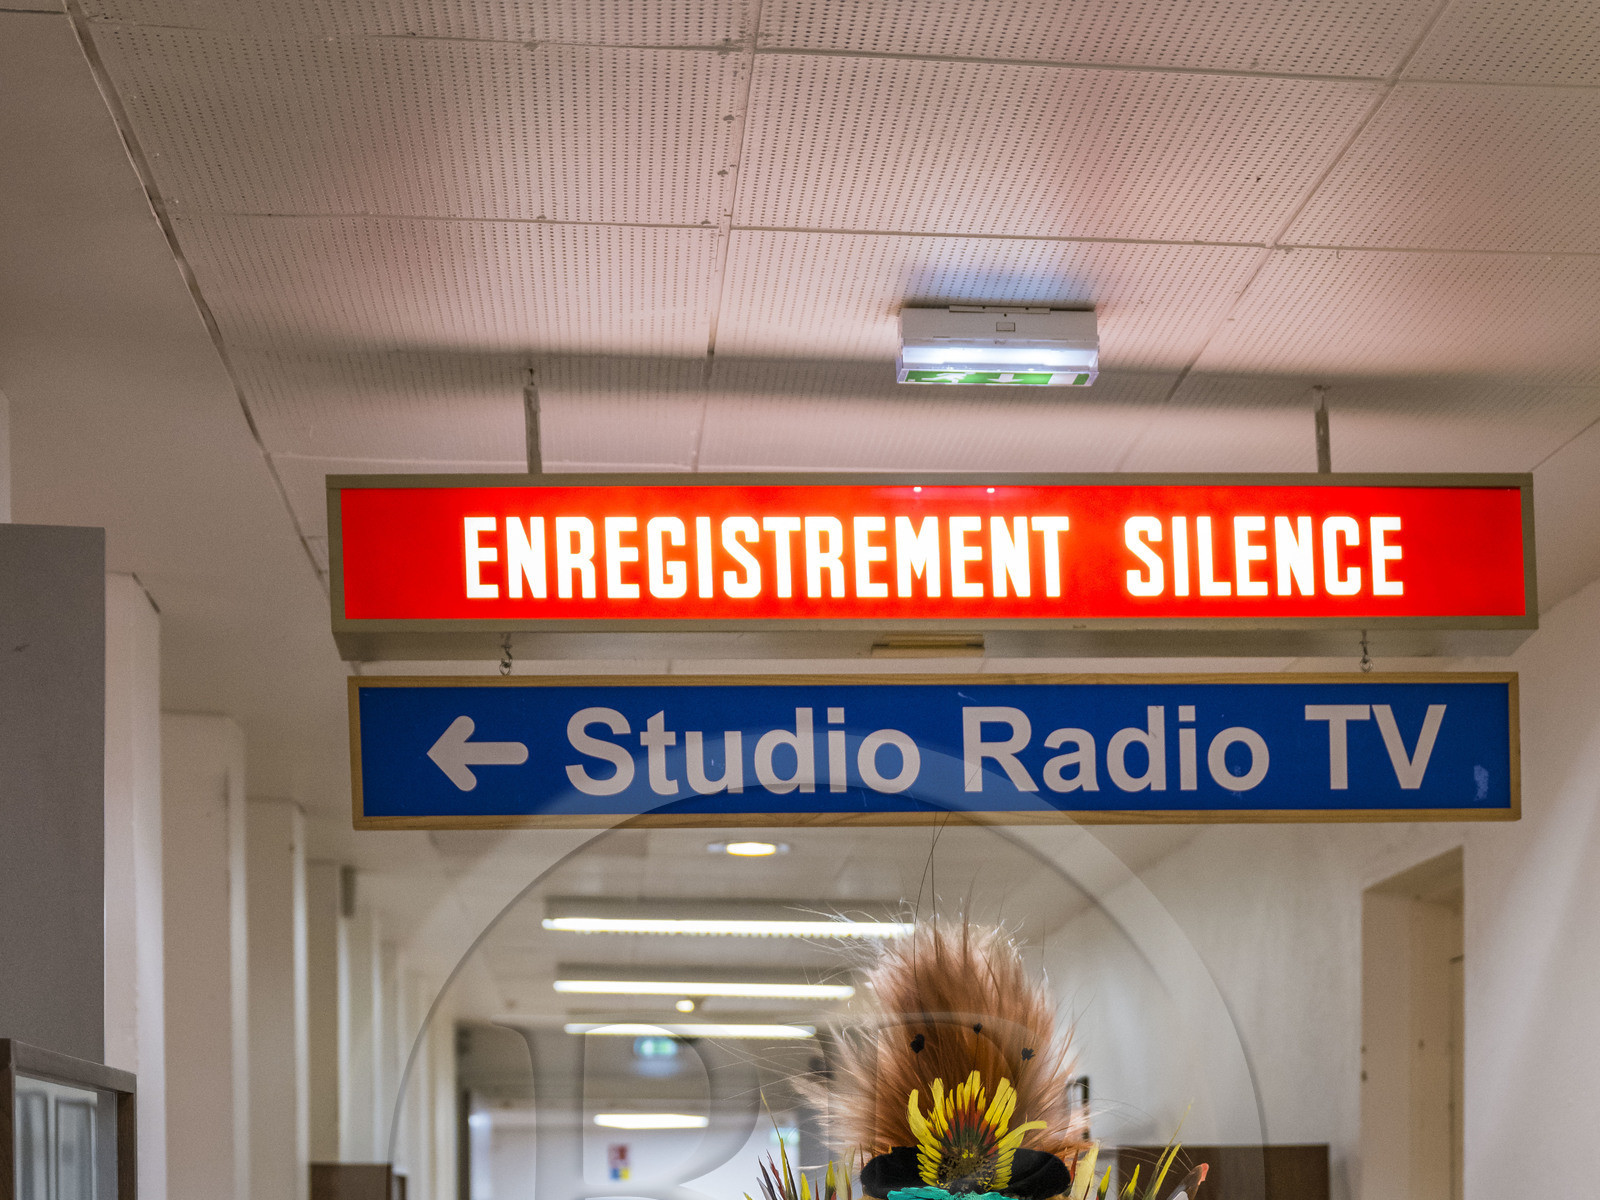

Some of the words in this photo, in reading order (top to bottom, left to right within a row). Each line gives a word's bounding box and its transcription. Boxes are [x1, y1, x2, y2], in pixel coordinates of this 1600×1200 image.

[463, 515, 1070, 598] ENREGISTREMENT
[1124, 515, 1404, 598] SILENCE
[565, 706, 921, 795] Studio
[962, 705, 1270, 793] Radio
[1304, 704, 1446, 790] TV
